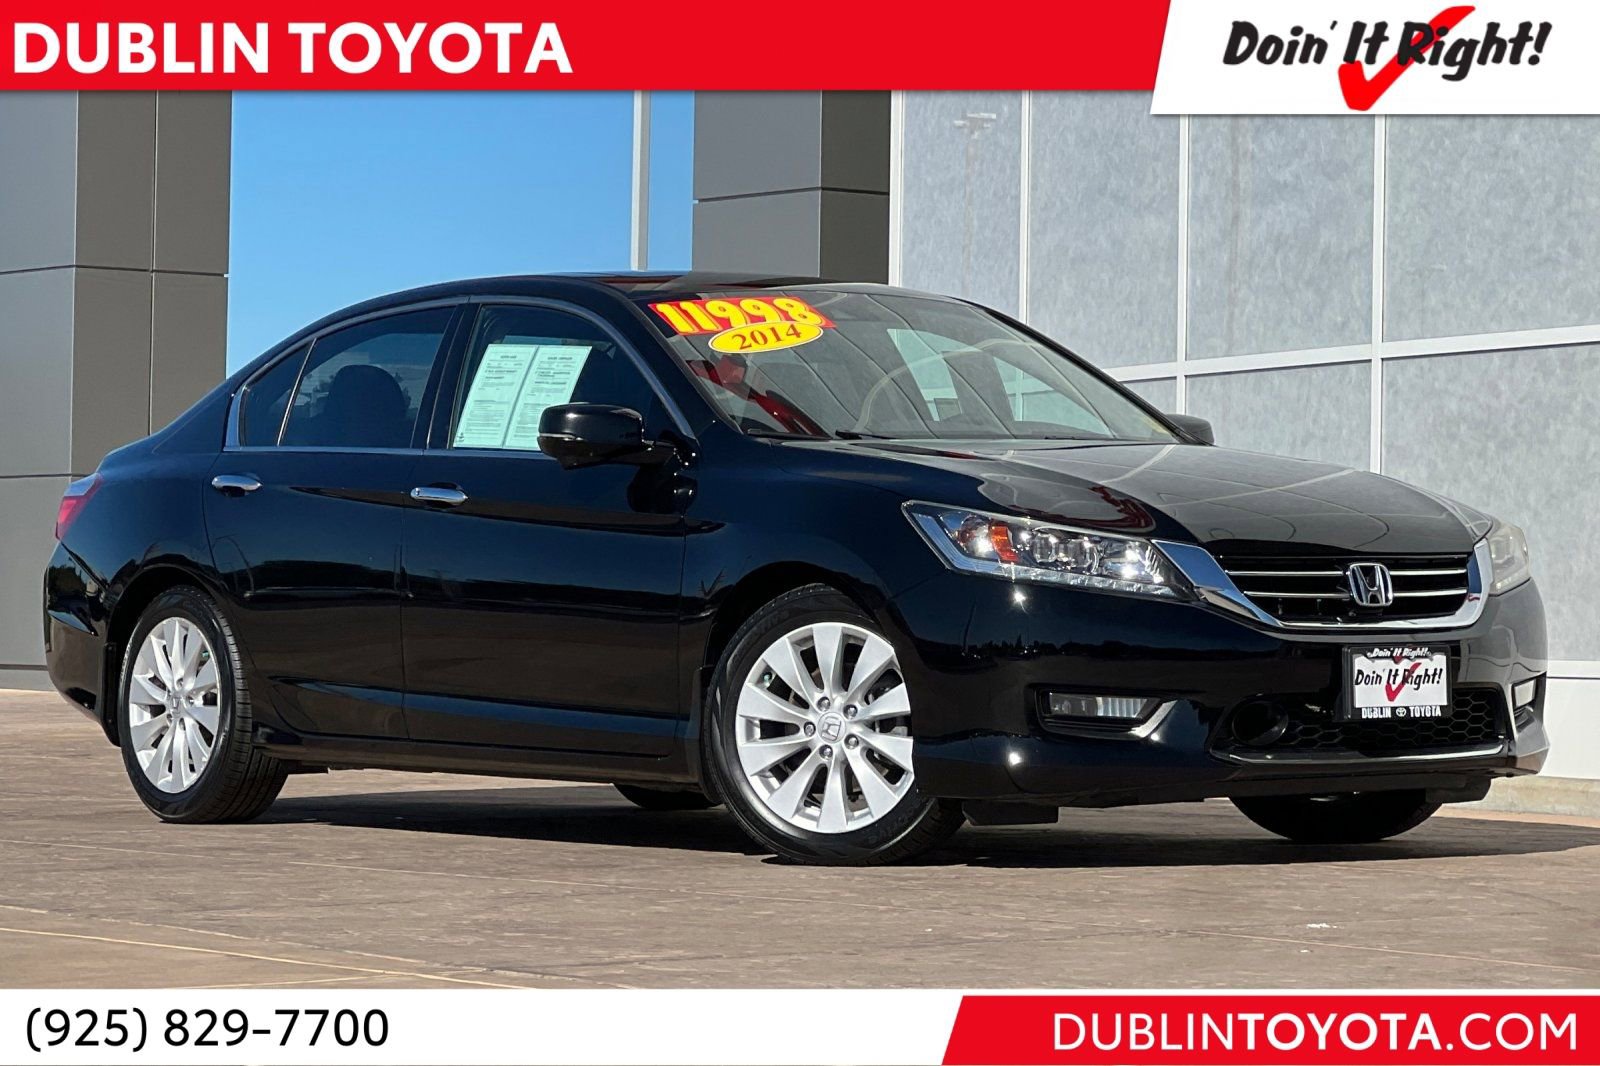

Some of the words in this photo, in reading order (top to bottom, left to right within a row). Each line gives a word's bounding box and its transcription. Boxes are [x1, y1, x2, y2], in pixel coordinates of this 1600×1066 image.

[656, 298, 823, 333] 11998
[731, 323, 802, 350] 2014
[1402, 647, 1428, 658] Right!
[1387, 668, 1399, 685] It
[1402, 668, 1443, 690] Right!
[1361, 706, 1392, 718] DUBLIN
[1409, 705, 1442, 717] TOYOTA
